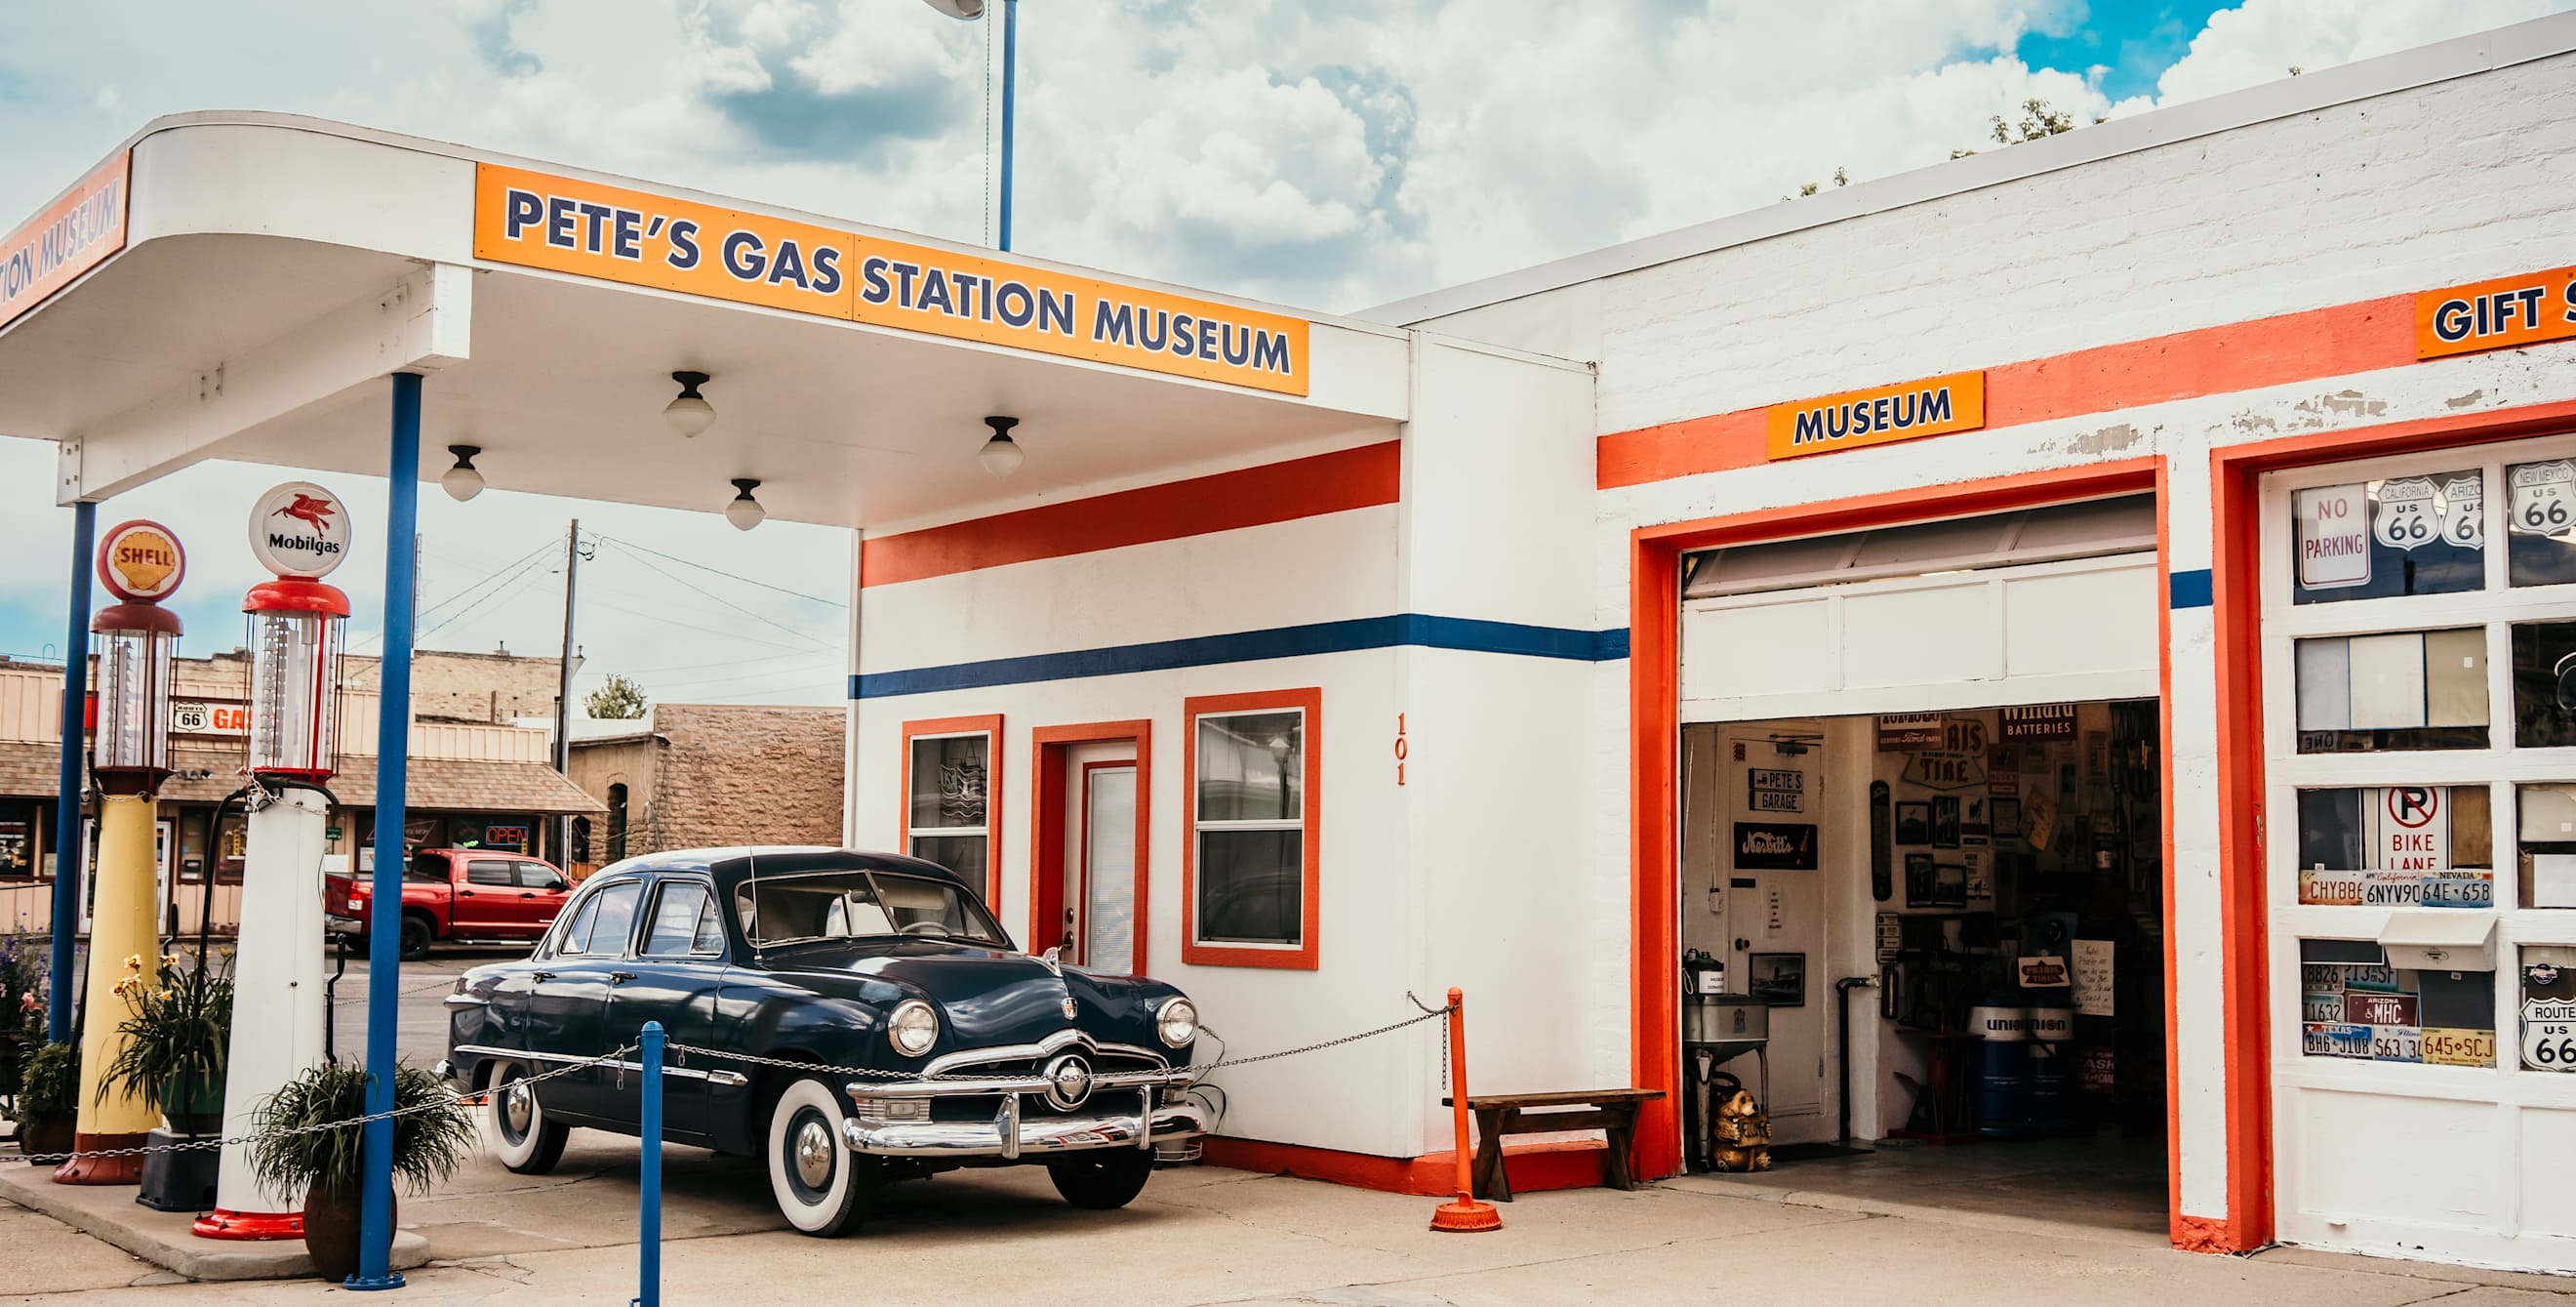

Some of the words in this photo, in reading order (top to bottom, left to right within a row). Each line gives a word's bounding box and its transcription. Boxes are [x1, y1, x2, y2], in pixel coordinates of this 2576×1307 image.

[37, 178, 118, 281] MUSEUM
[505, 187, 701, 271] PETE'S
[722, 230, 843, 295] GAS
[861, 255, 1074, 336] STATION
[1092, 297, 1293, 375] MUSEUM
[2434, 286, 2546, 342] GIFT
[1793, 387, 1952, 445] MUSEUM
[2519, 470, 2537, 484] NEW
[2538, 467, 2569, 482] MEXICO
[2385, 484, 2430, 500] CALIFORNIA
[2533, 487, 2556, 498] US
[2317, 498, 2348, 520] NO
[2396, 504, 2418, 513] US
[2525, 499, 2568, 527] 66
[2389, 514, 2428, 541] 66
[268, 533, 340, 555] Mobilgas
[2306, 534, 2363, 560] PARKING
[120, 547, 171, 567] SHELL
[181, 713, 201, 726] 66
[213, 708, 252, 730] GA
[2007, 721, 2072, 736] BATTERIES
[1394, 712, 1408, 786] 101
[1920, 758, 1969, 783] TIRE
[1762, 793, 1797, 810] GARAGE
[487, 827, 529, 845] OPEN
[2393, 835, 2435, 852] BIKE
[2391, 857, 2436, 870] LANE
[2377, 872, 2420, 883] California
[2374, 1003, 2402, 1023] MHC
[2535, 1006, 2576, 1019] ROUTE
[2322, 1025, 2353, 1035] TEXAS
[2544, 1025, 2568, 1035] US
[2425, 1036, 2453, 1055] 645
[2536, 1038, 2576, 1064] 66
